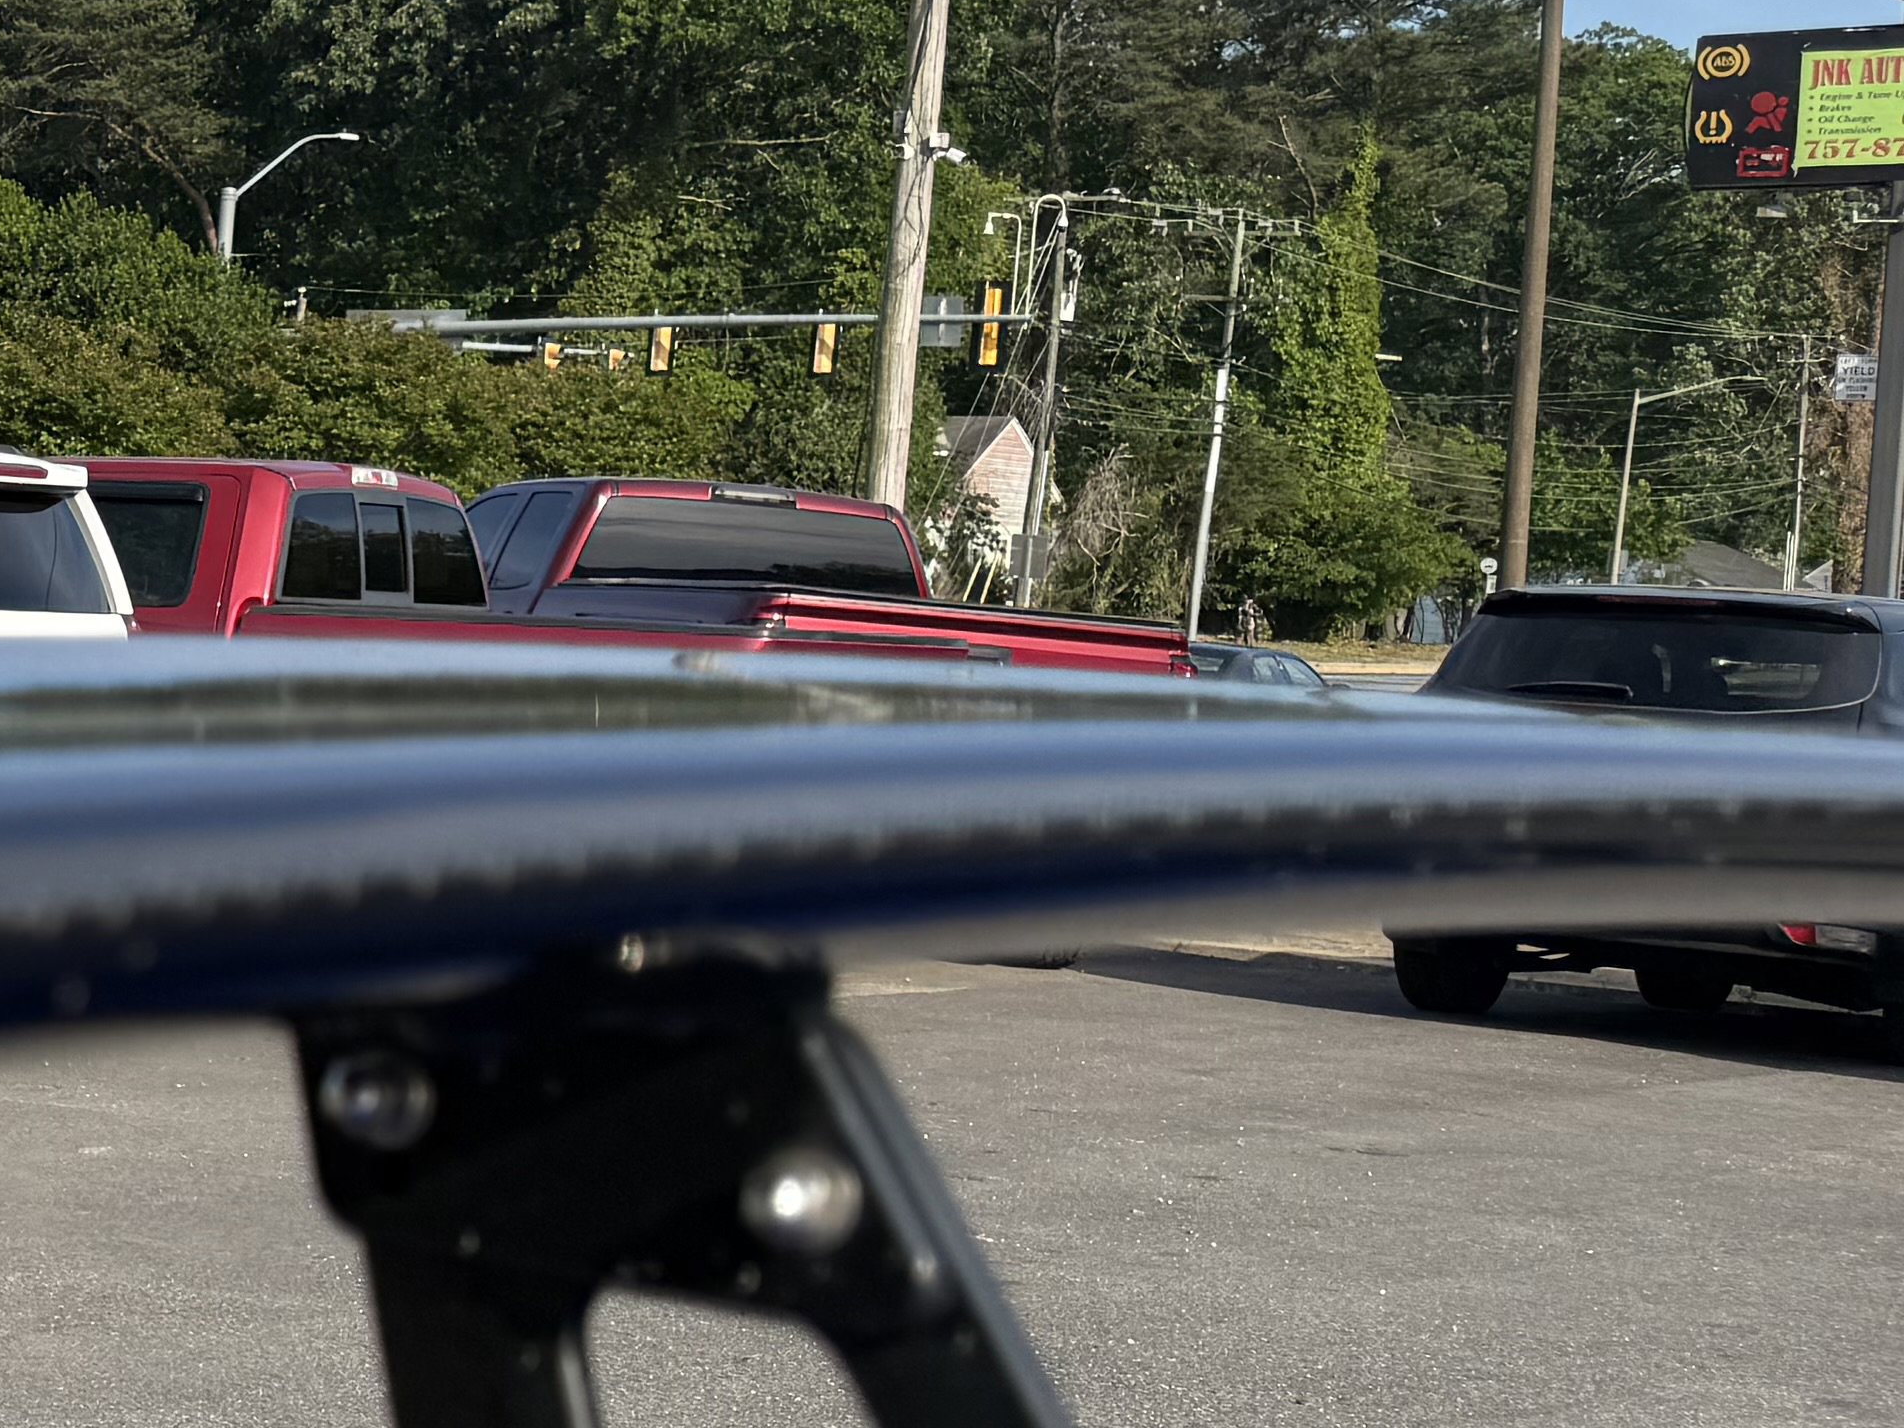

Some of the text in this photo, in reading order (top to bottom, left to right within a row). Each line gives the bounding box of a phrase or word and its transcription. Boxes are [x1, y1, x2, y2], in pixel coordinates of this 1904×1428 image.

[1809, 58, 1852, 90] JNK
[1819, 104, 1852, 113] Brakes
[1818, 114, 1876, 125] Oil Change
[1818, 125, 1882, 135] Transmission
[1842, 366, 1876, 376] YIELD
